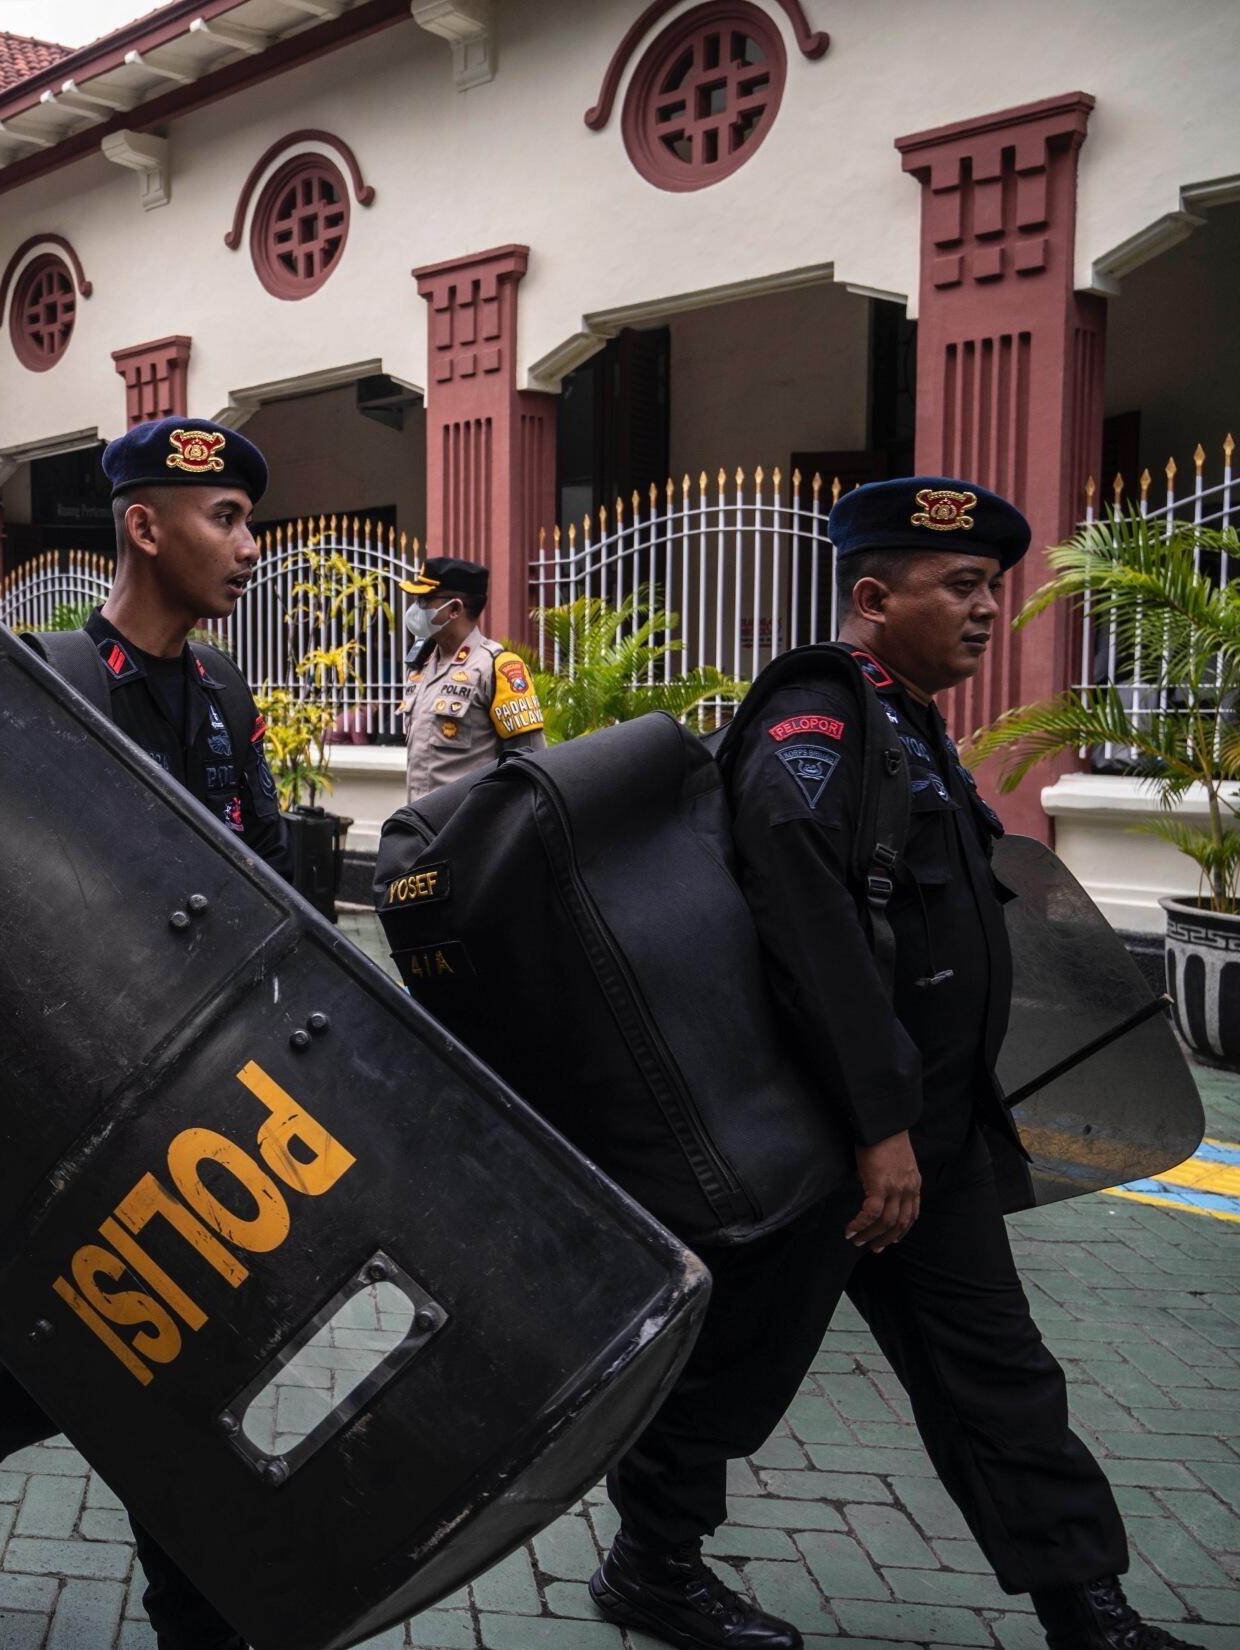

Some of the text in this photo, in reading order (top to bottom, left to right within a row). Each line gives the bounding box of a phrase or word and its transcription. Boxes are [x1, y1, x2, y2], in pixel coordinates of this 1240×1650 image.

[441, 684, 471, 698] POLRI
[775, 718, 839, 737] PELOPOR
[206, 765, 237, 788] POL
[389, 871, 438, 904] YOSEF
[52, 1059, 357, 1387] POLISI
